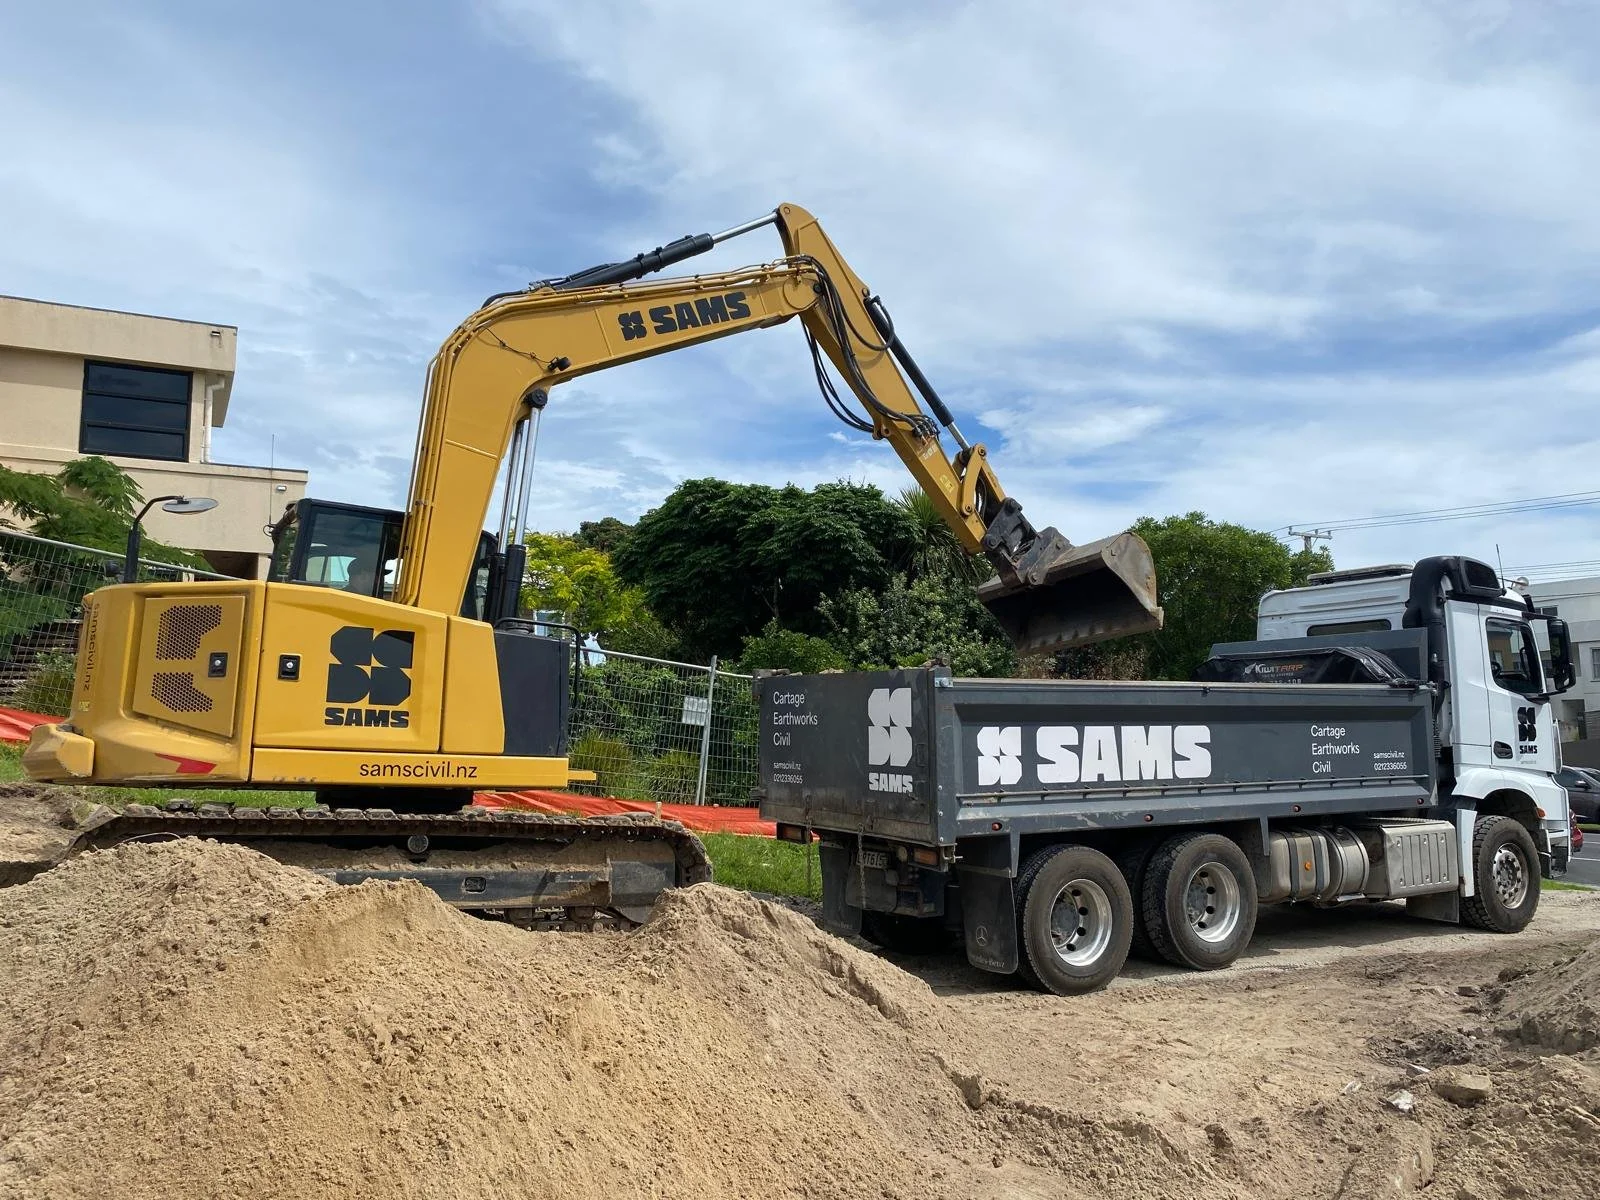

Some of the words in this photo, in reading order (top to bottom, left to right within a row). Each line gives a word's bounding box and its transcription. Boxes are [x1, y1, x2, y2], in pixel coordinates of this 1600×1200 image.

[649, 291, 751, 335] SAMS
[773, 691, 805, 707] Cartage
[324, 707, 410, 728] SAMS
[773, 711, 818, 725] Earthworks
[773, 732, 791, 746] Civil
[1310, 725, 1346, 739] Cartage
[1036, 725, 1212, 783] SAMS
[1311, 742, 1360, 755] Earthworks
[1373, 751, 1405, 759] samscivil.nz
[1519, 745, 1538, 754] SAMS
[359, 760, 478, 778] samscivil.nz
[1312, 761, 1331, 773] Civil
[868, 772, 913, 793] SAMS
